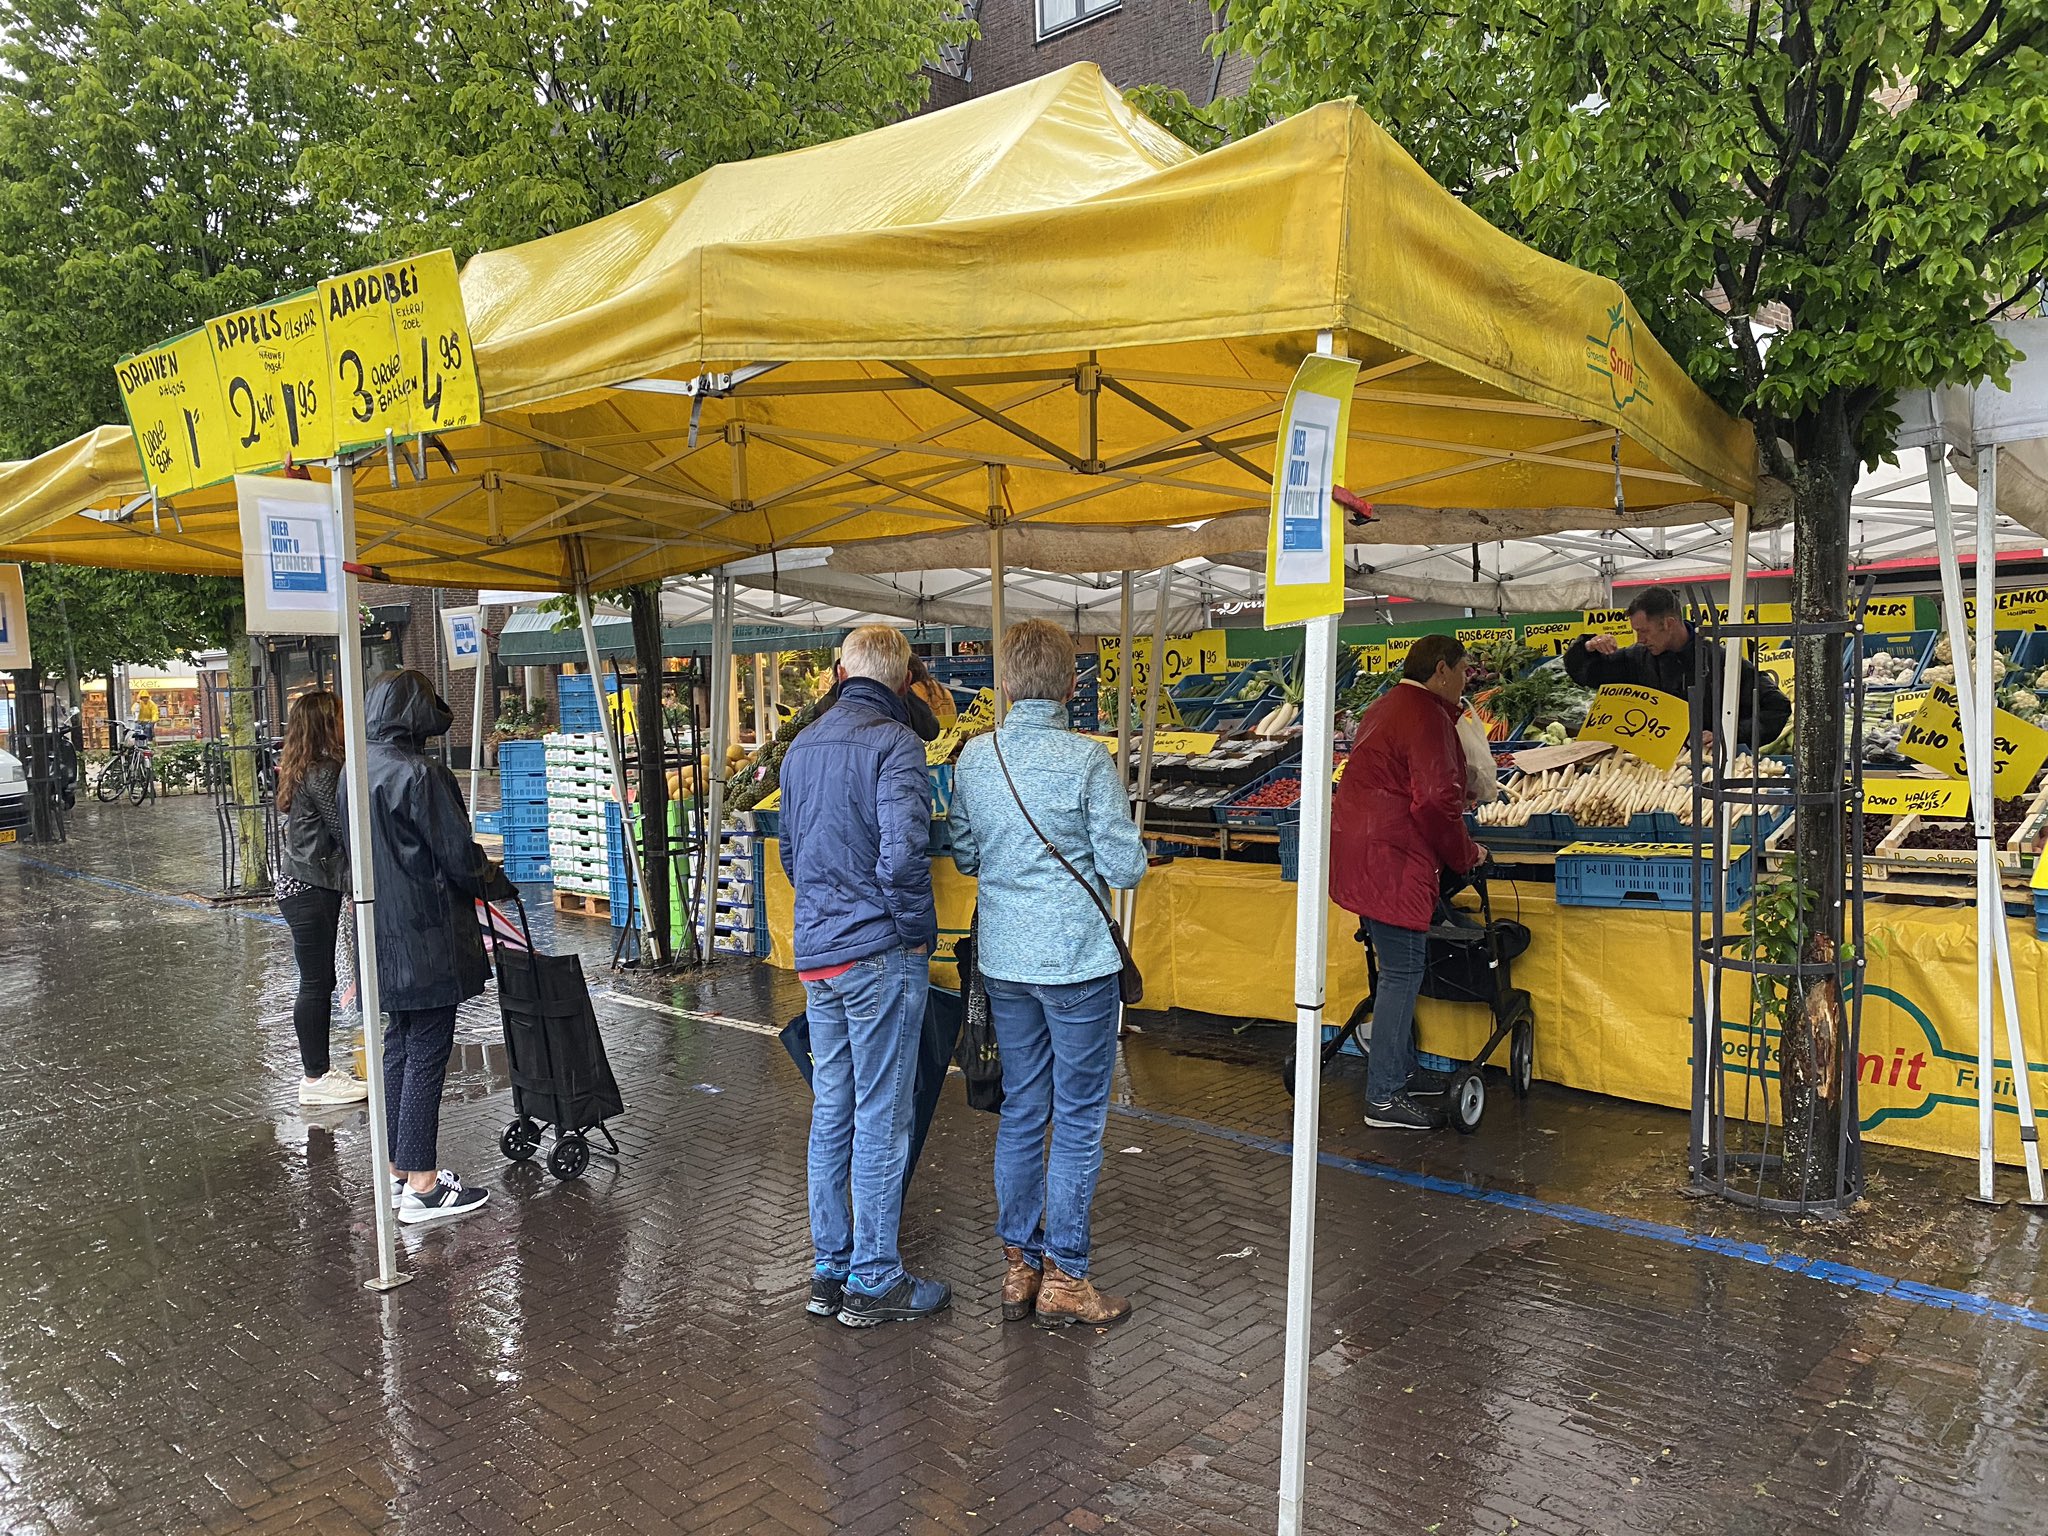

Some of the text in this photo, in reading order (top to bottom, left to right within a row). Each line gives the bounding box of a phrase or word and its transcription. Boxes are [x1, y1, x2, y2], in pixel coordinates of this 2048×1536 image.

[215, 309, 282, 352] APPELS
[1610, 346, 1634, 384] Smit
[340, 349, 374, 423] 3
[229, 376, 261, 449] 2
[270, 520, 289, 536] HIER
[272, 538, 299, 554] KUNT U
[274, 554, 314, 572] PINNEN
[1103, 659, 1116, 683] 5
[1165, 649, 1182, 679] 2
